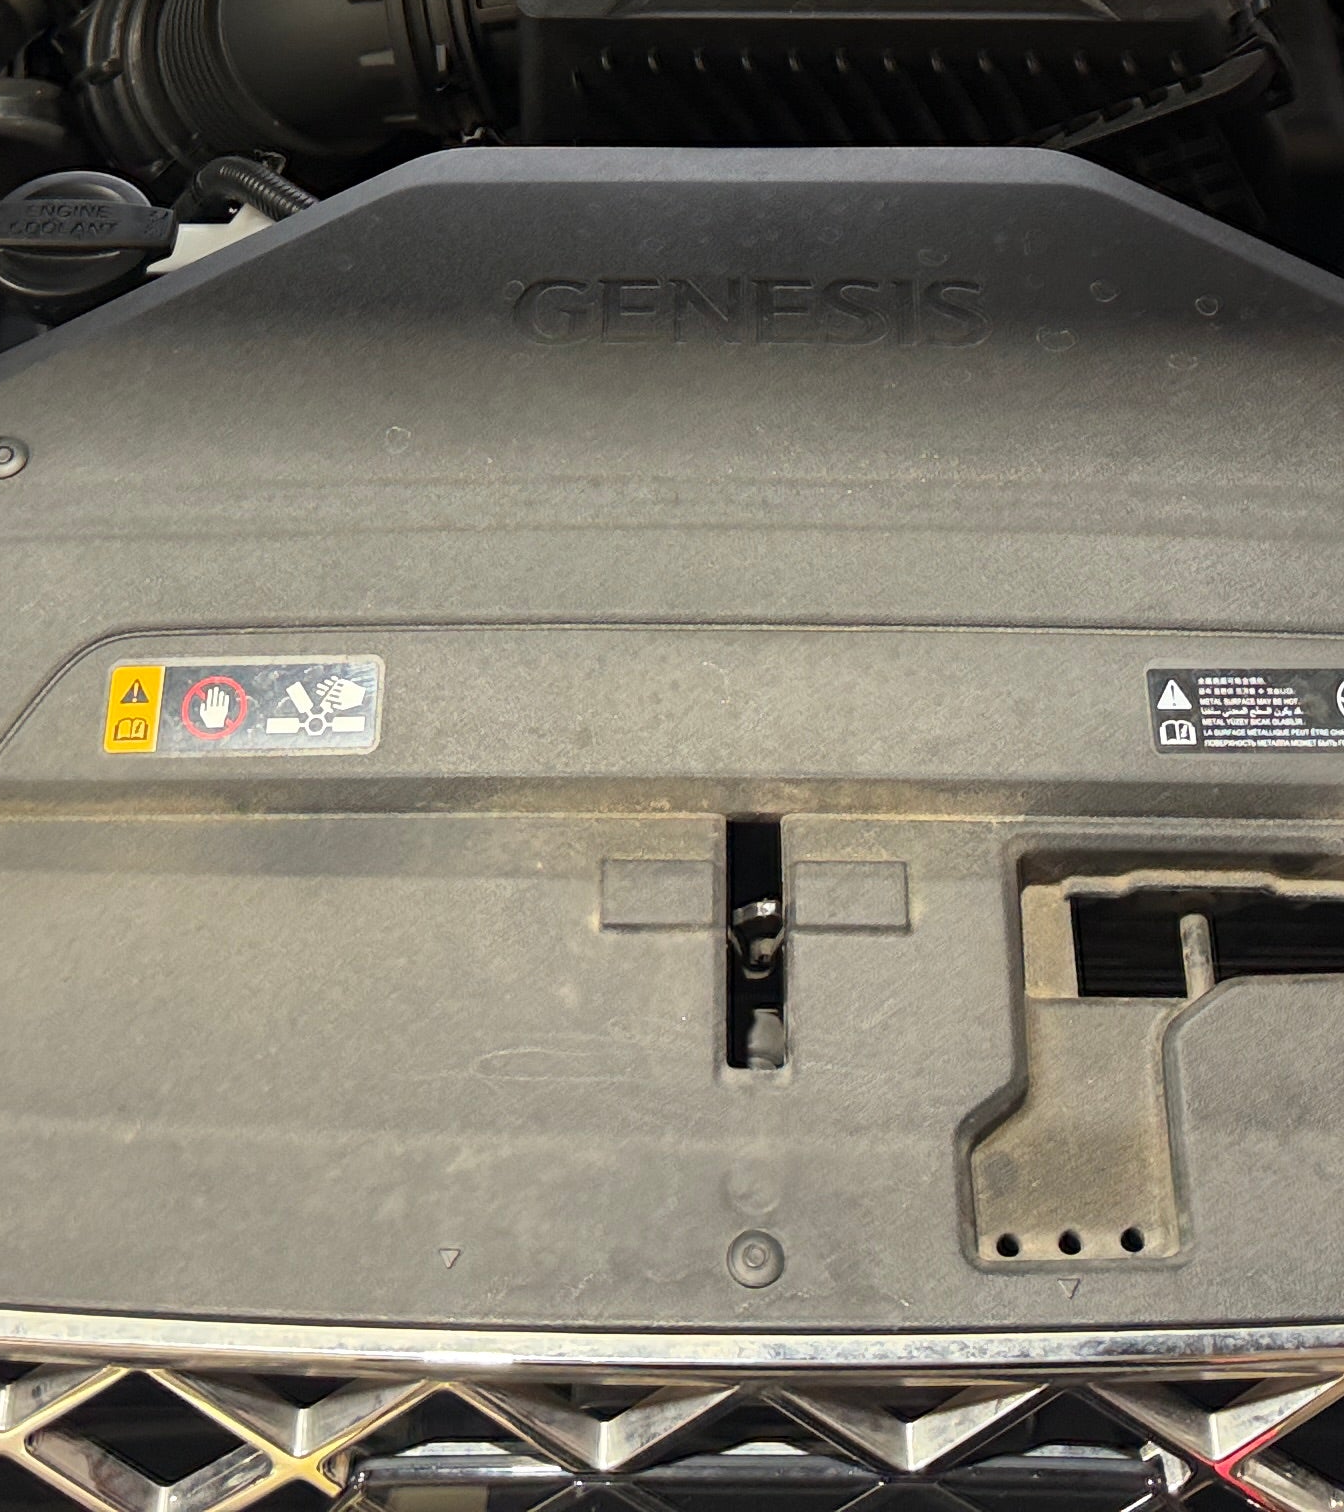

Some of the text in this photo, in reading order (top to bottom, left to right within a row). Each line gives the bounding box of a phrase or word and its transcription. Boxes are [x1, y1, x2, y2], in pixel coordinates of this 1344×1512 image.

[25, 203, 113, 219] ENGINE
[9, 221, 120, 236] COOLANT
[512, 277, 992, 349] GENESIS
[1199, 698, 1223, 706] METAL
[1223, 698, 1256, 706] SURFACE
[1256, 698, 1272, 706] MAY
[1272, 698, 1283, 706] BE
[1201, 718, 1226, 726] METAL
[1202, 729, 1213, 737] LA
[1290, 729, 1310, 737] PEUT
[1310, 727, 1330, 737] ÊTRE
